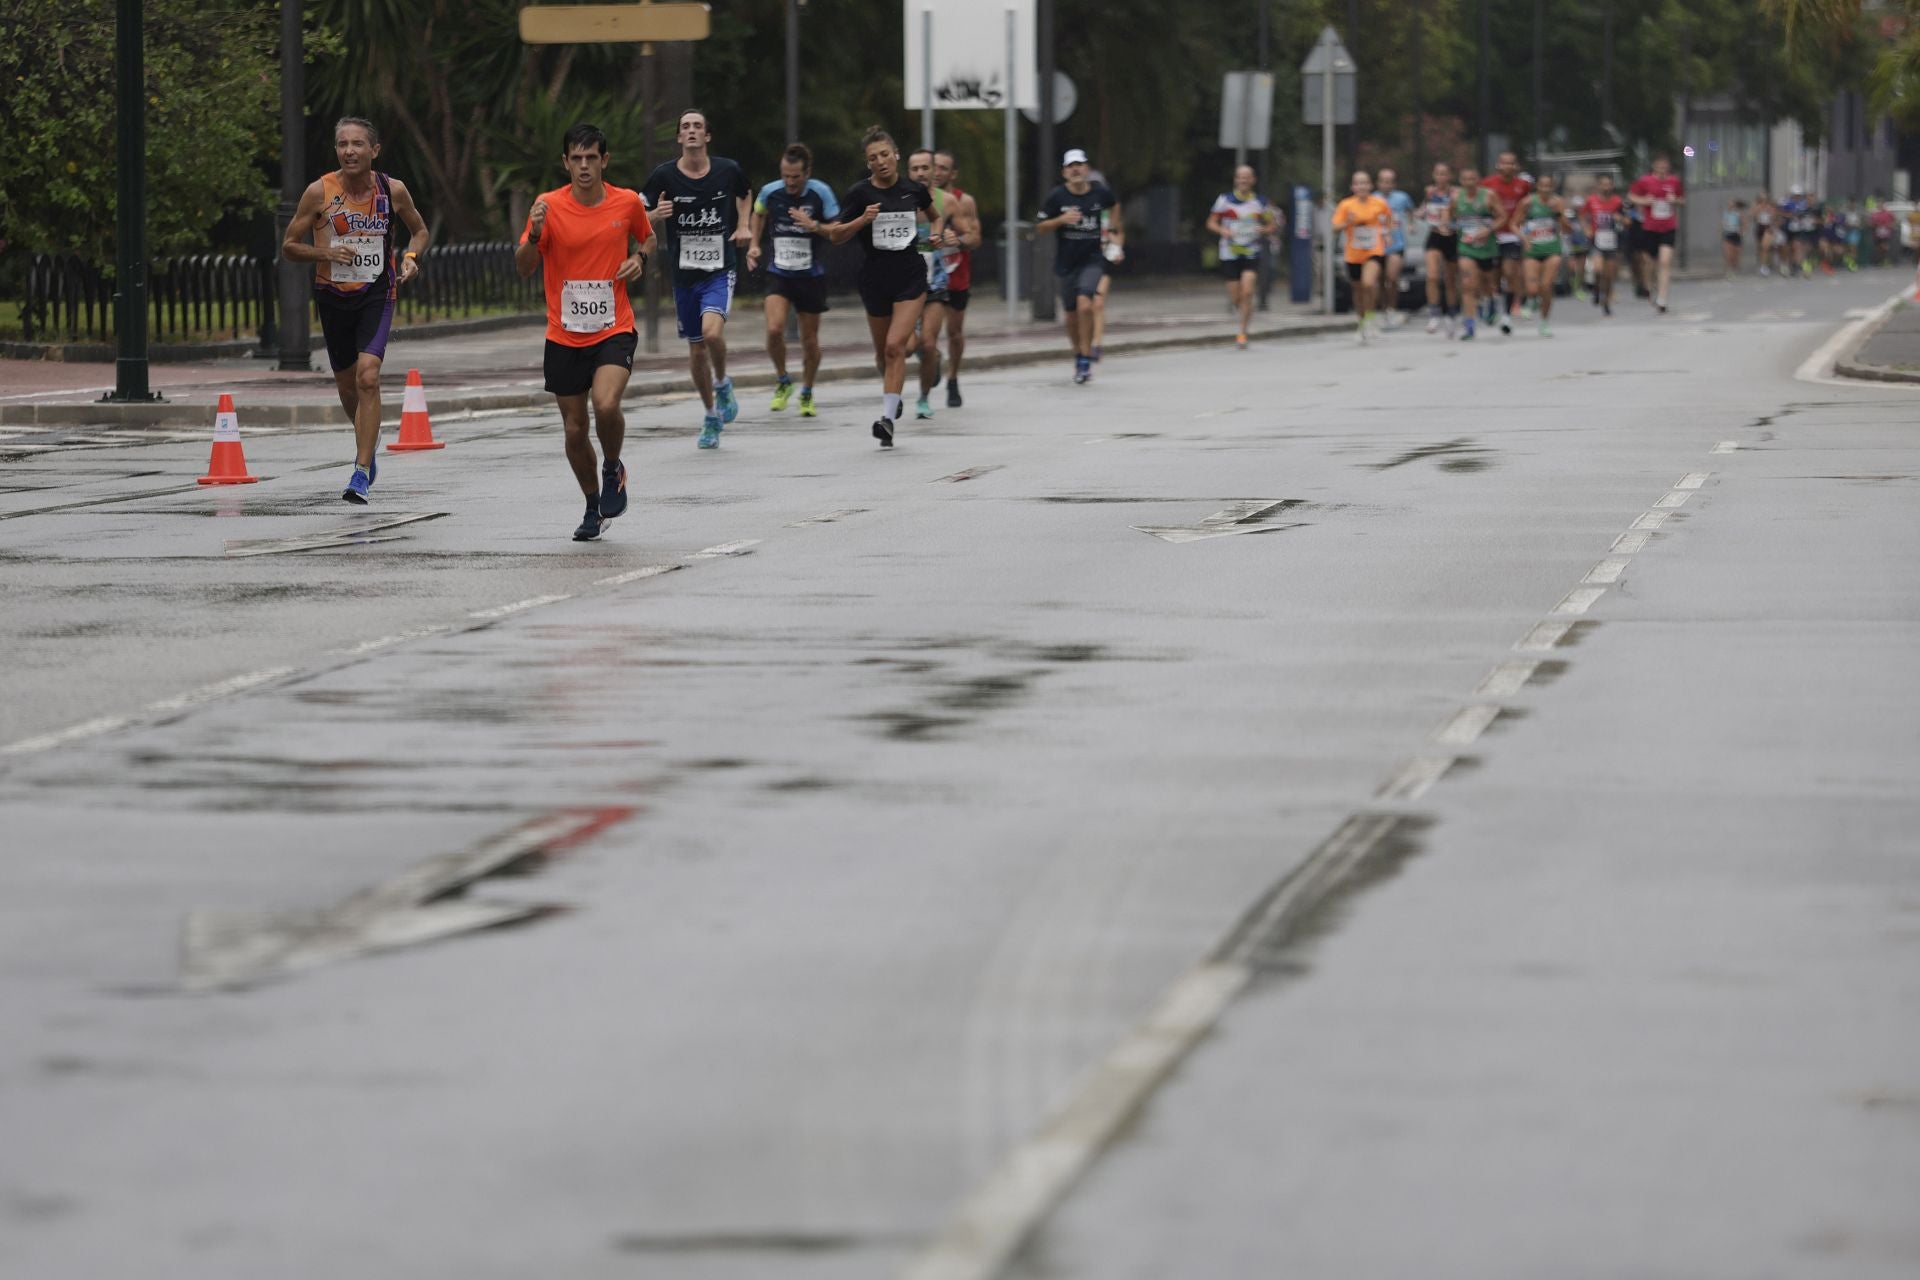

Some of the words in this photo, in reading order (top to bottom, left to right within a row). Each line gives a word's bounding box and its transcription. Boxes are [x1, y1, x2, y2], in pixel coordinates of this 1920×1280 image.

[880, 227, 909, 239] 1455
[685, 250, 720, 261] 11233
[571, 301, 607, 315] 3505
